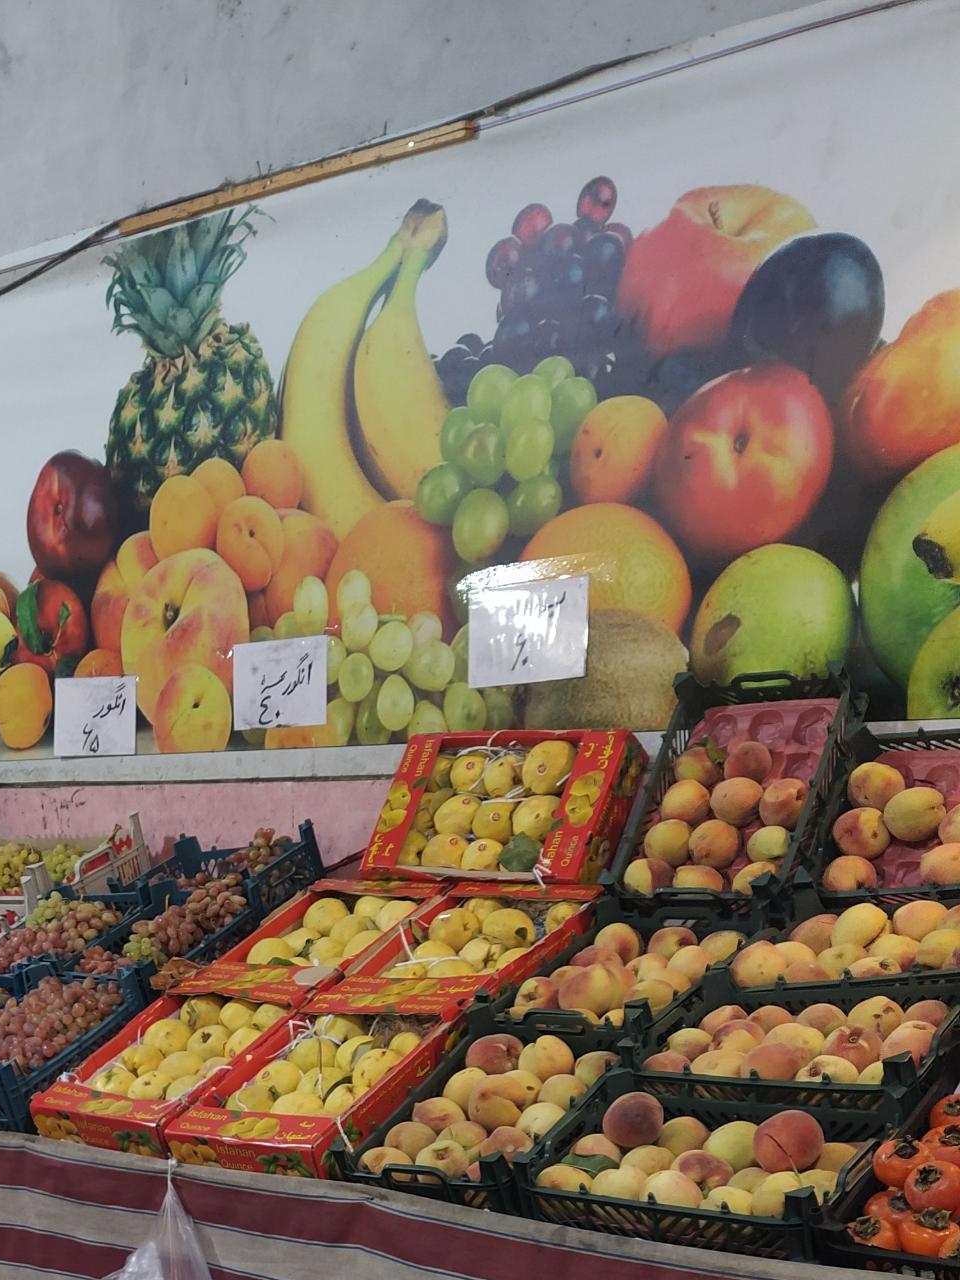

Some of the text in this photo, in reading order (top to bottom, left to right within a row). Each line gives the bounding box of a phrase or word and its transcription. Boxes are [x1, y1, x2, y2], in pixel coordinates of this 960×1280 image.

[281, 652, 314, 696] انگور
[92, 682, 127, 719] انگور
[81, 722, 100, 753] ۶۵
[596, 729, 617, 769] اصفهان
[401, 744, 418, 773] Quince
[414, 739, 435, 777] Isfahan
[559, 834, 580, 868] Quince
[189, 1108, 229, 1122] Isfahan
